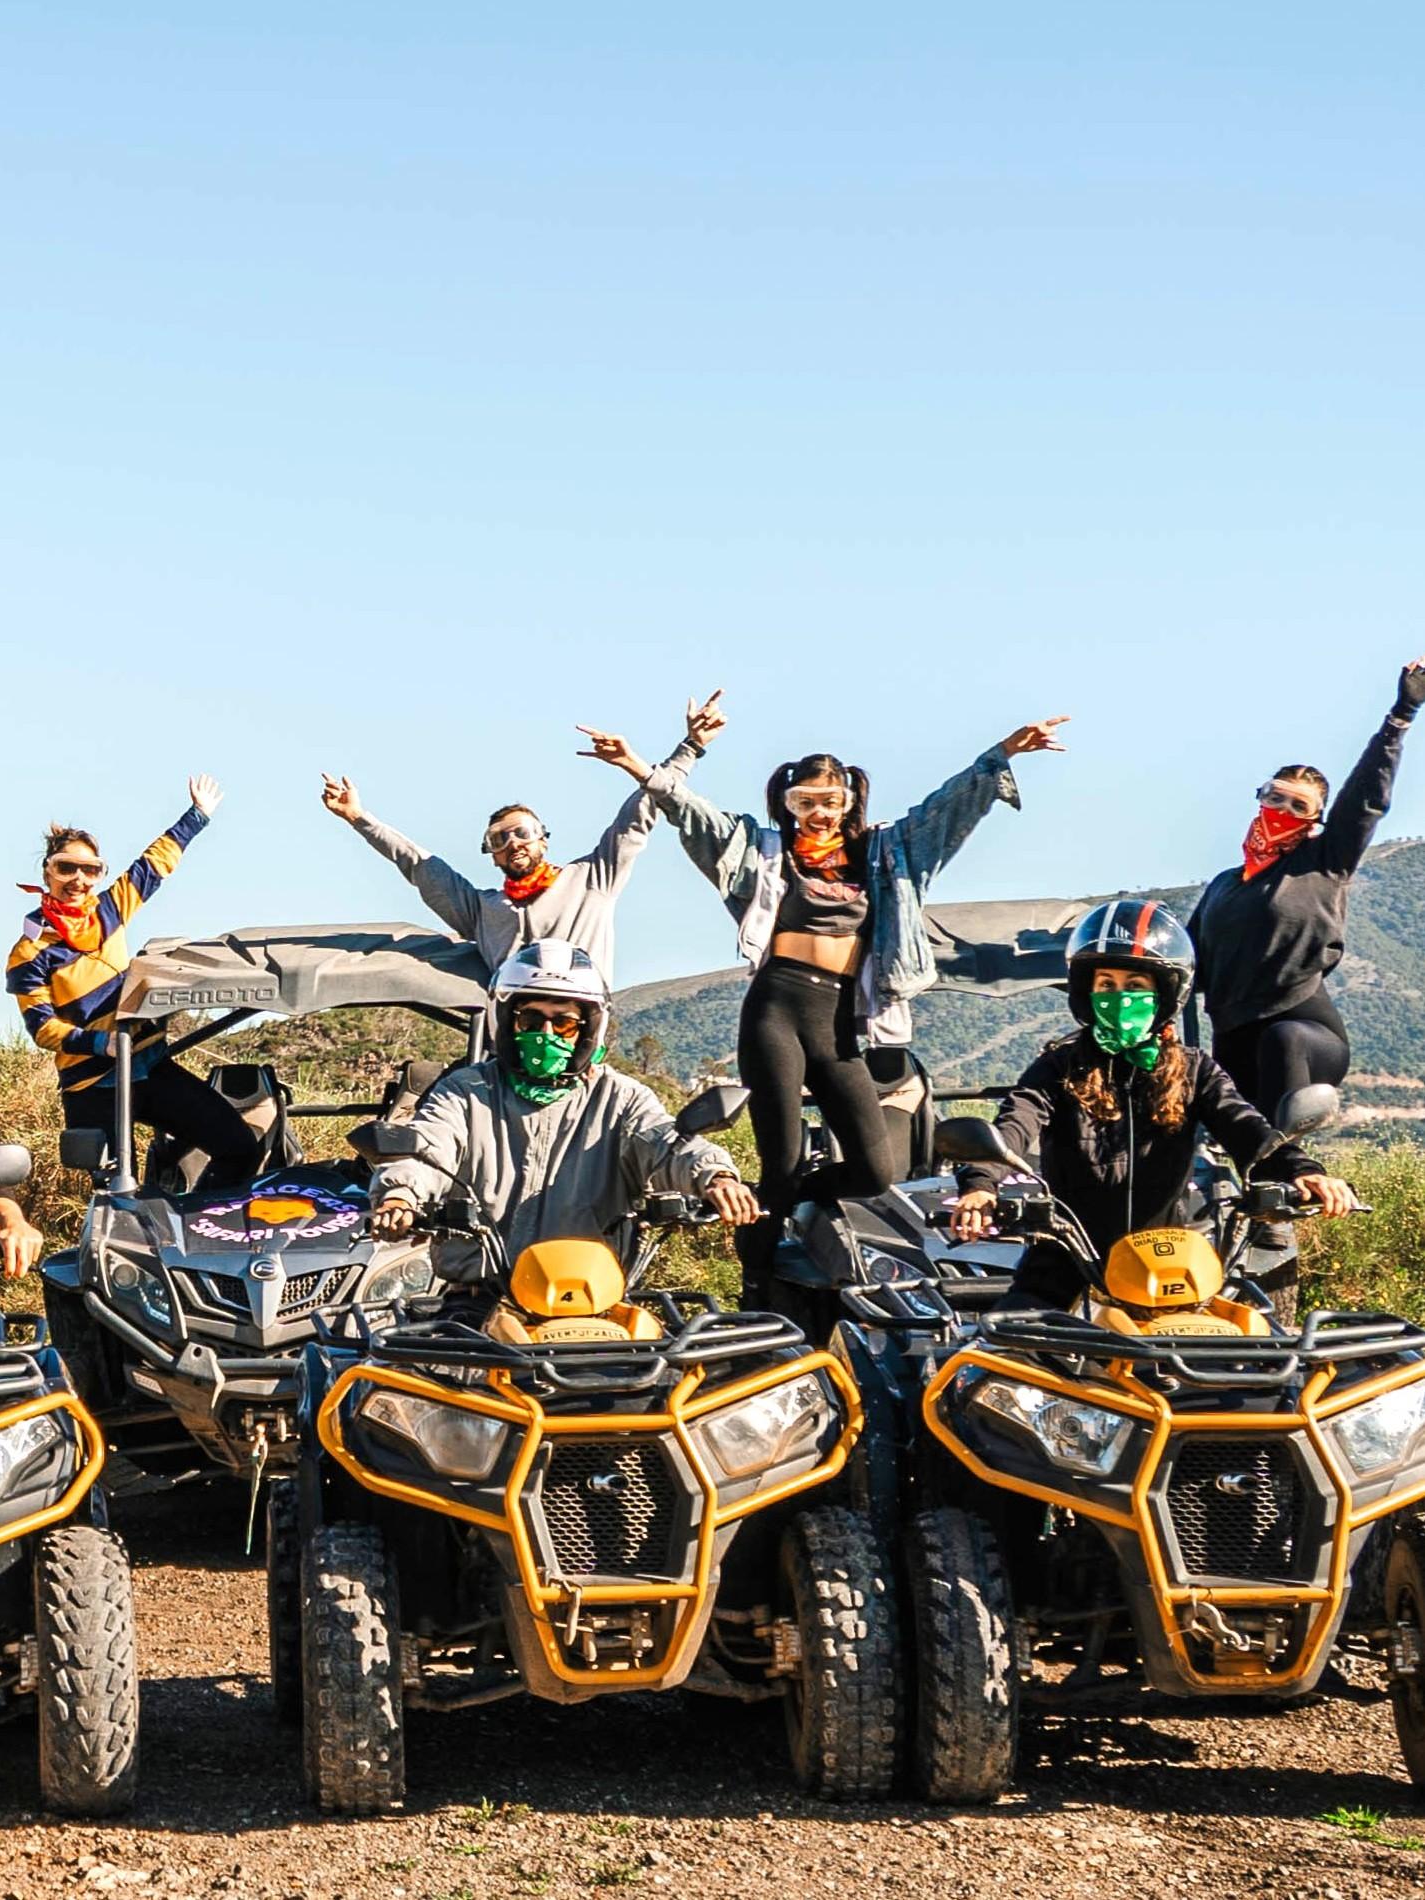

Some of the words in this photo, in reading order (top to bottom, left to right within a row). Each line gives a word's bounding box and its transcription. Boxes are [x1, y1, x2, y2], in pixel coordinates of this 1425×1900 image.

[148, 986, 278, 1006] CFMOTO
[1162, 1283, 1186, 1296] 12
[560, 1291, 574, 1303] 4
